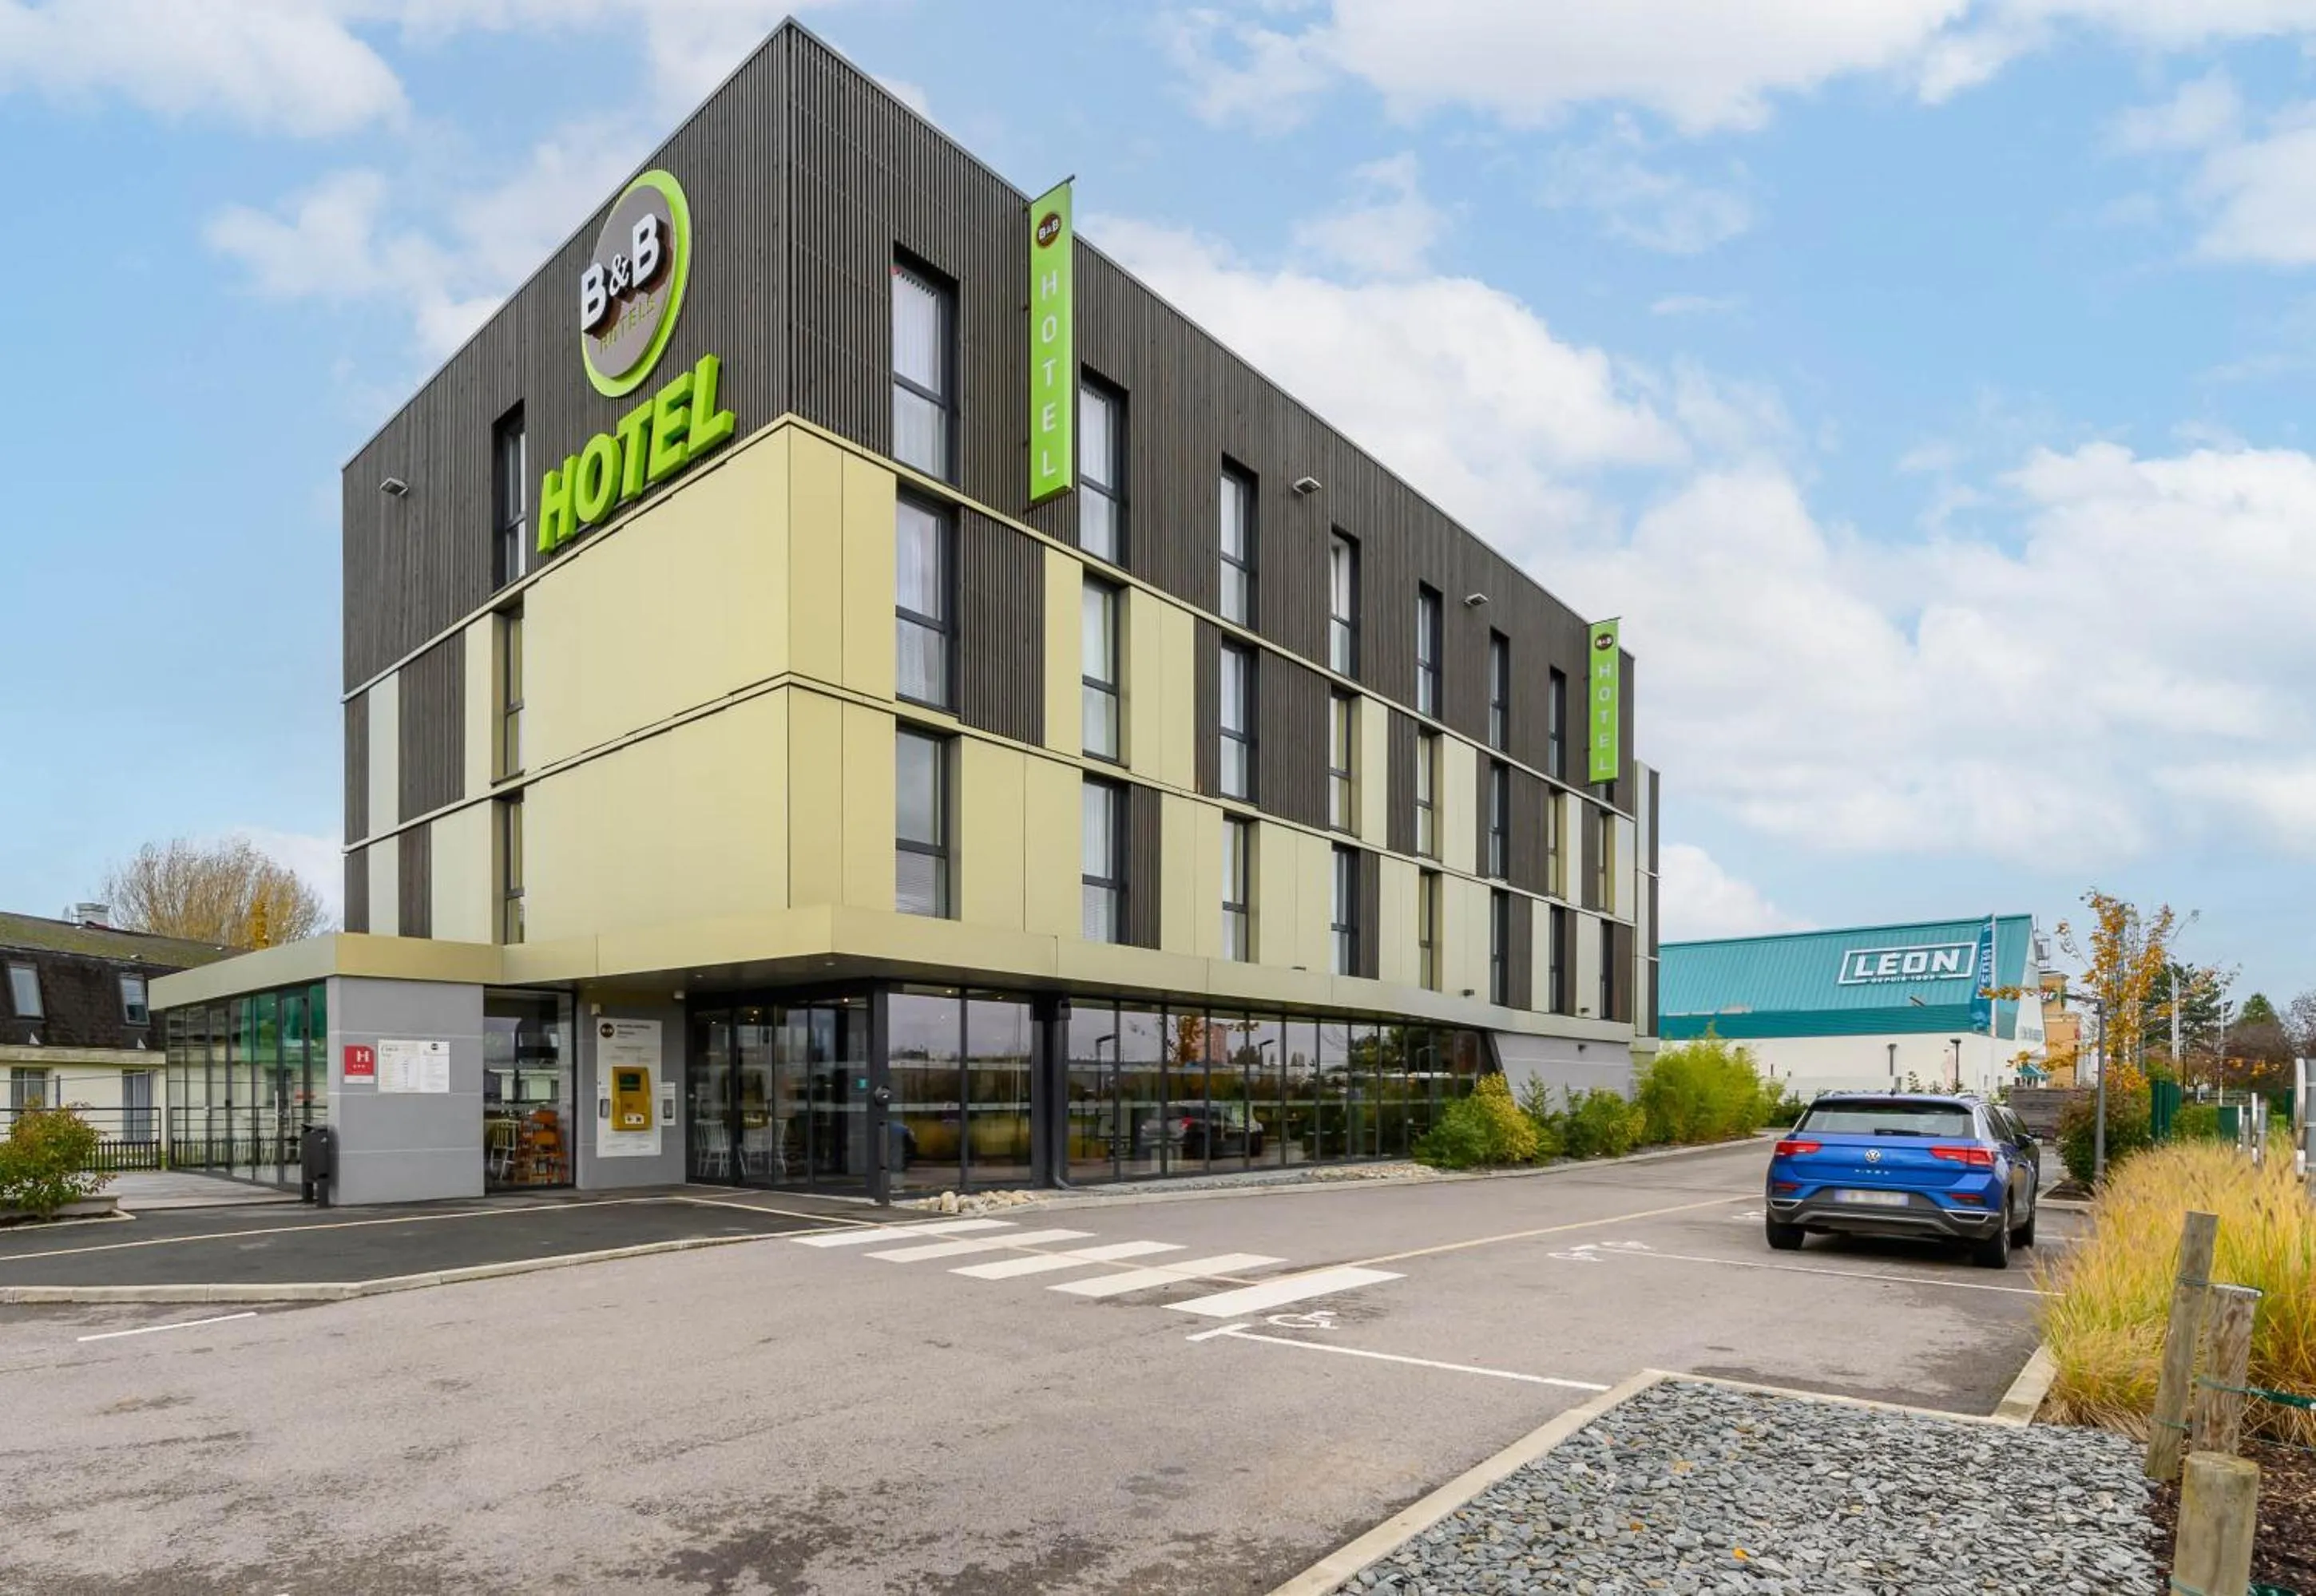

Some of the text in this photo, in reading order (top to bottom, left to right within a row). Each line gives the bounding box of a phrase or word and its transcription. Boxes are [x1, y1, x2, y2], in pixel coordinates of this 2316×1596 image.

[581, 212, 666, 334] B&B
[1041, 269, 1058, 477] HOTEL
[537, 354, 735, 553] HOTEL
[1598, 662, 1612, 771] HOTEL
